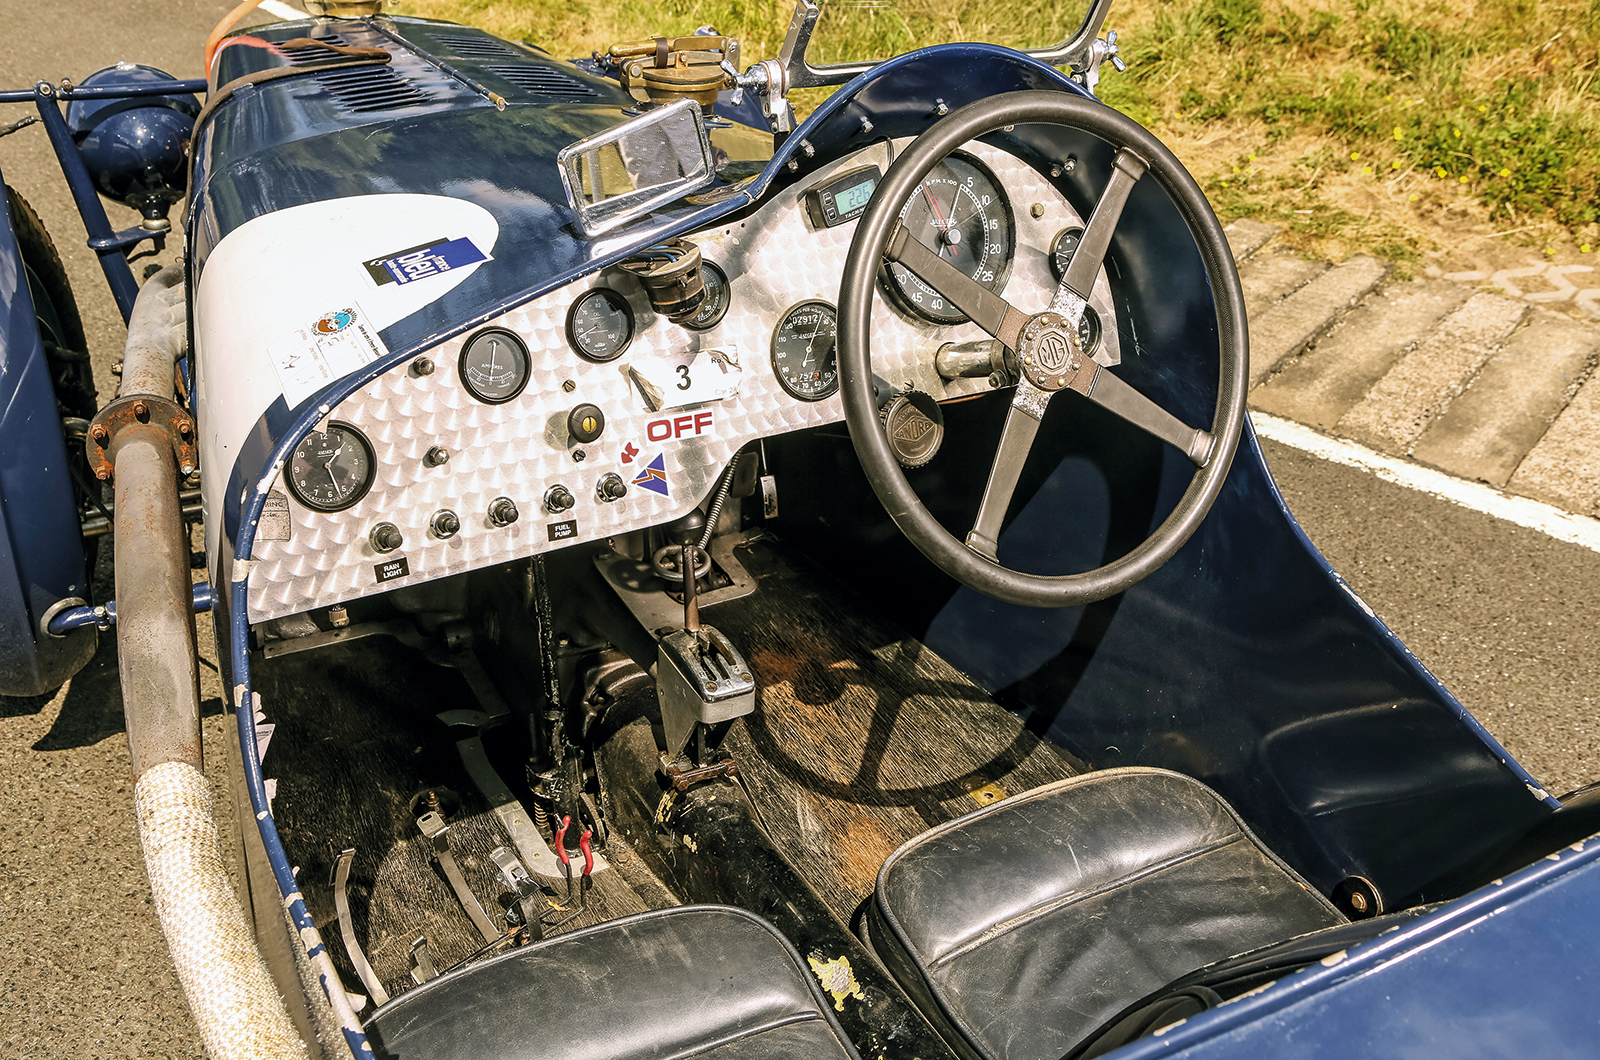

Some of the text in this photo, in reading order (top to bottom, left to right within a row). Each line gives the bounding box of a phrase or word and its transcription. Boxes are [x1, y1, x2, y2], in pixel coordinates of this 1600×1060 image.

[967, 177, 974, 188] 5
[981, 195, 990, 206] 10
[989, 219, 998, 230] 15
[990, 244, 1001, 254] 20
[397, 248, 439, 281] bleu
[982, 270, 994, 282] 25
[911, 292, 923, 303] 45
[931, 299, 943, 310] 40
[1041, 336, 1066, 366] MG
[675, 364, 692, 391] 3
[646, 411, 713, 442] OFF
[554, 524, 570, 532] FUEL
[554, 529, 572, 538] PUMP
[383, 562, 400, 573] RAIN
[383, 568, 403, 579] LIGHT
